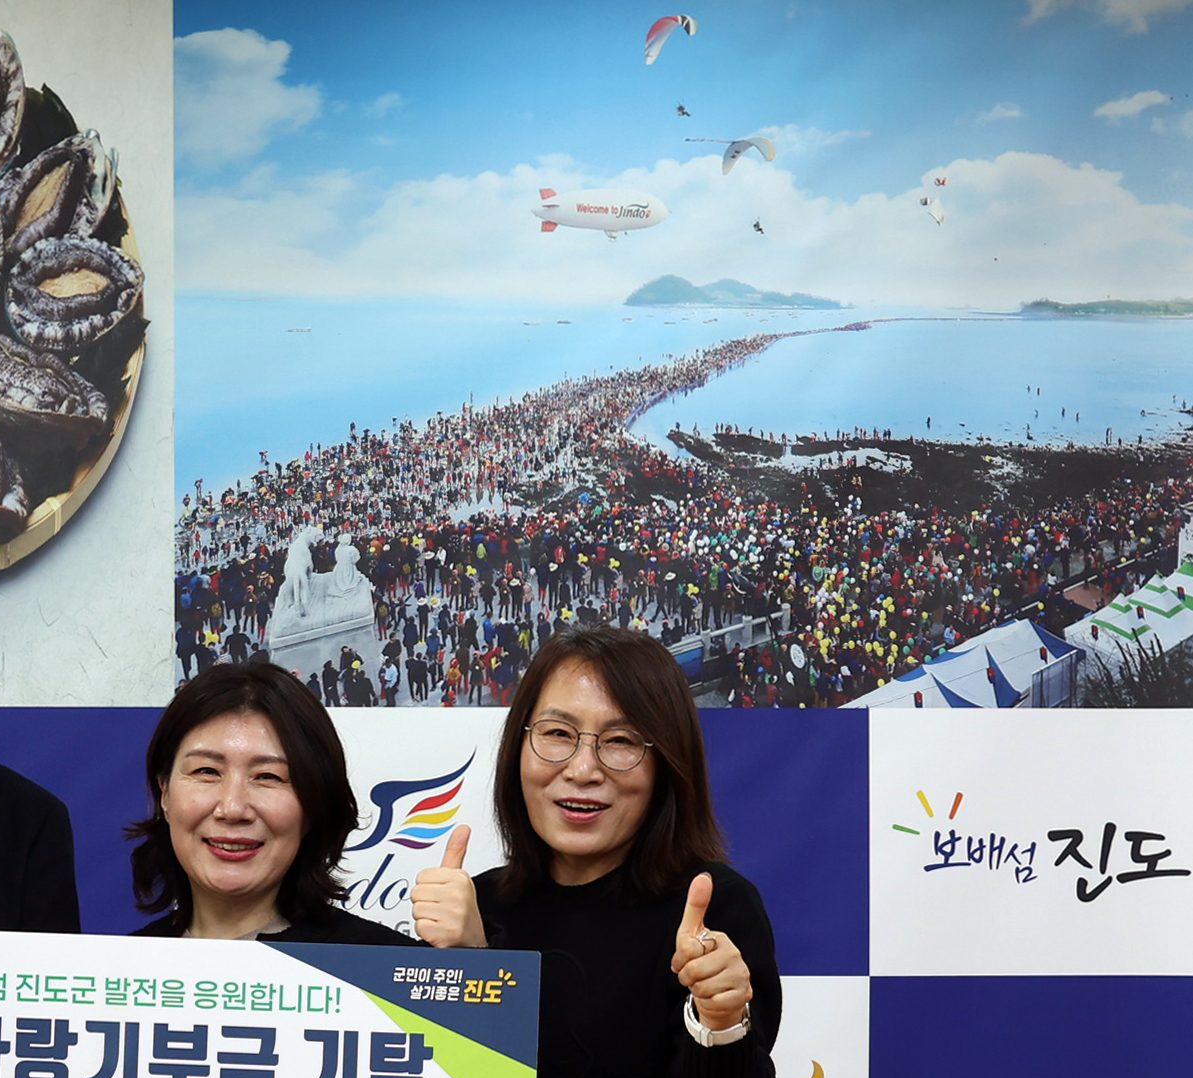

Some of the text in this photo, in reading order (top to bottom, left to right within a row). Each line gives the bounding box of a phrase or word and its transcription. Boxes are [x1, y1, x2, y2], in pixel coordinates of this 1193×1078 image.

[576, 203, 609, 215] Welcome
[616, 205, 646, 219] Jindo
[924, 821, 1192, 903] 보배섬 진도
[393, 967, 463, 984] 군민이 주인!
[15, 974, 97, 1005] 진도군
[105, 977, 186, 1008] 발전을
[193, 981, 343, 1014] 응원합니다!
[464, 979, 503, 1003] 진도
